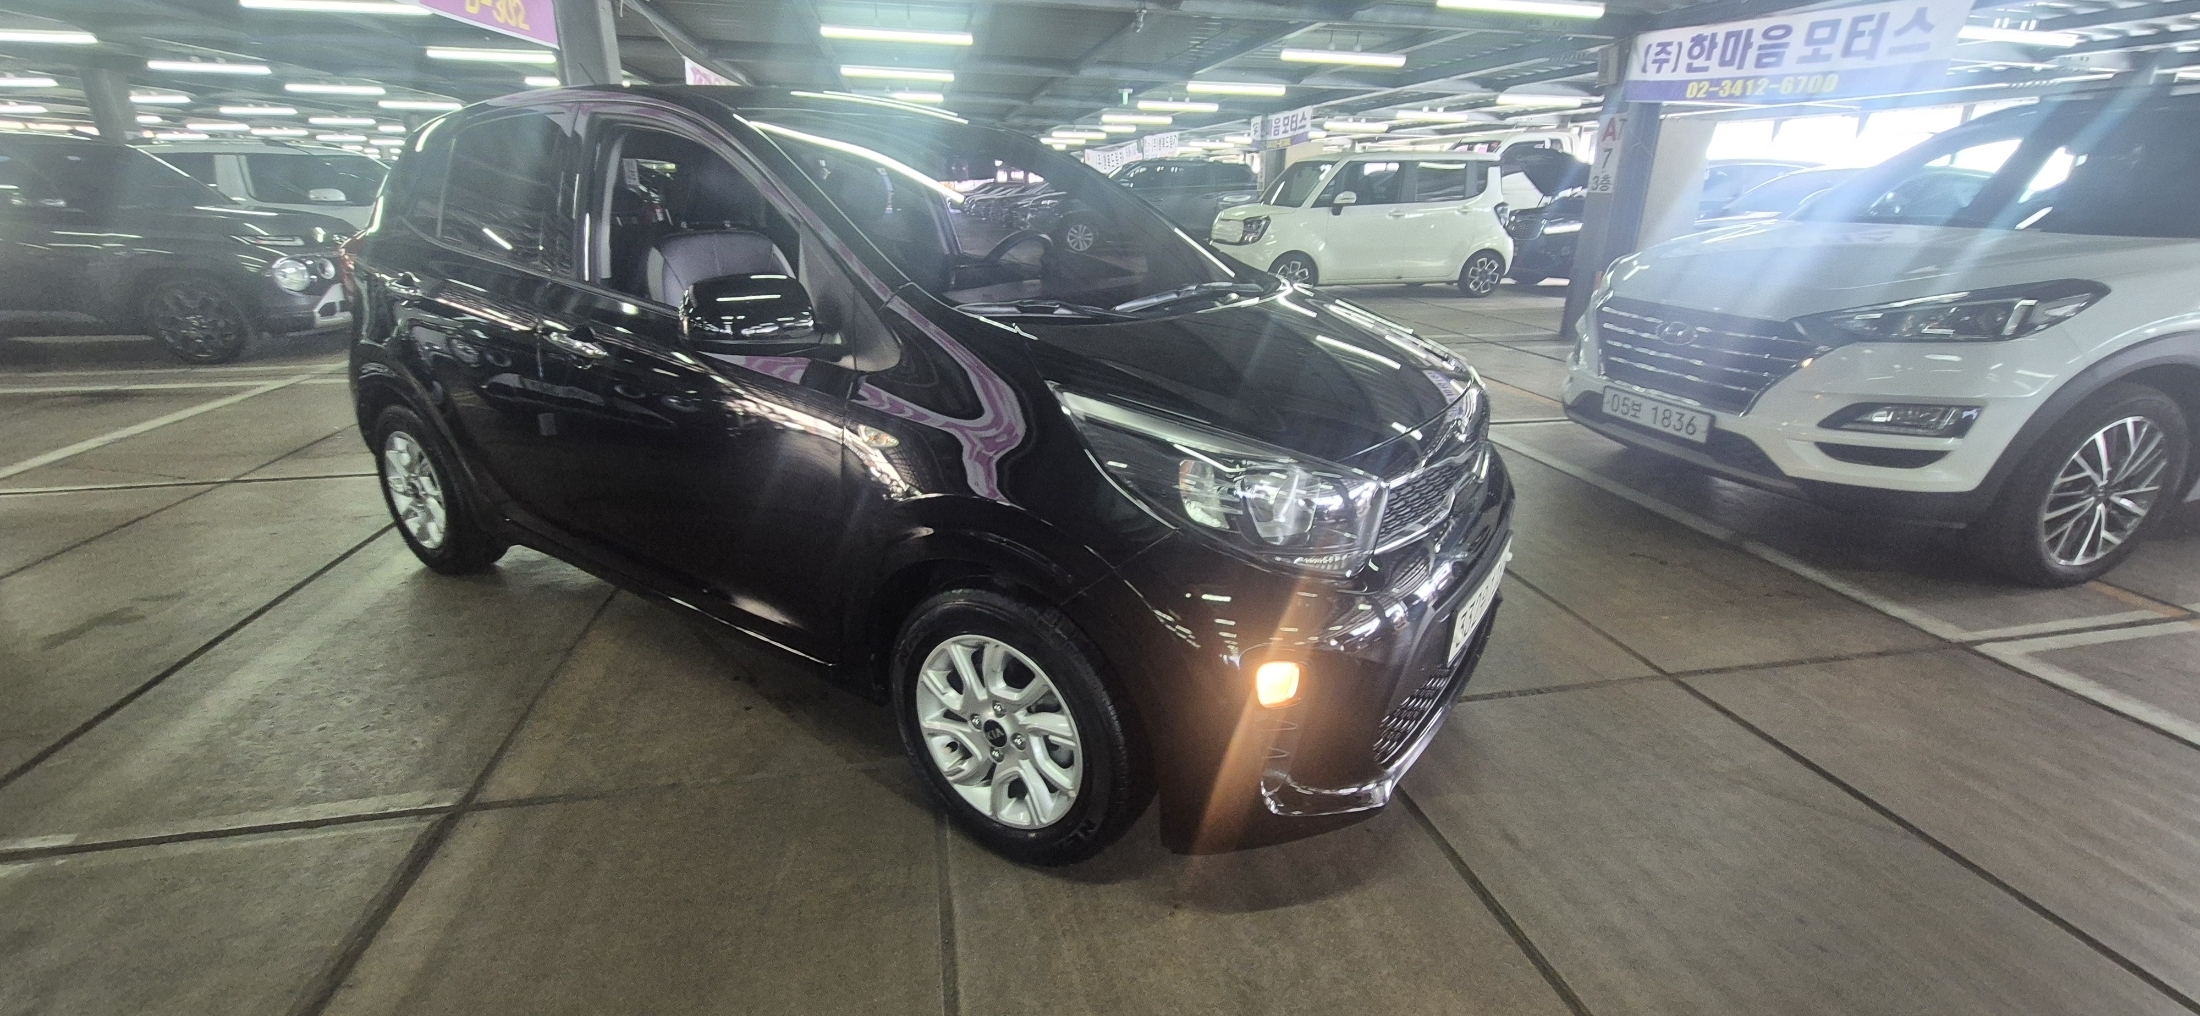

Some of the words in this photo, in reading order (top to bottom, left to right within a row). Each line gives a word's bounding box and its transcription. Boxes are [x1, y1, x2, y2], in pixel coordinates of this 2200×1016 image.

[1796, 7, 1936, 65] 모터스
[1686, 74, 1839, 99] 02-3412-6700
[1652, 406, 1697, 435] 1836
